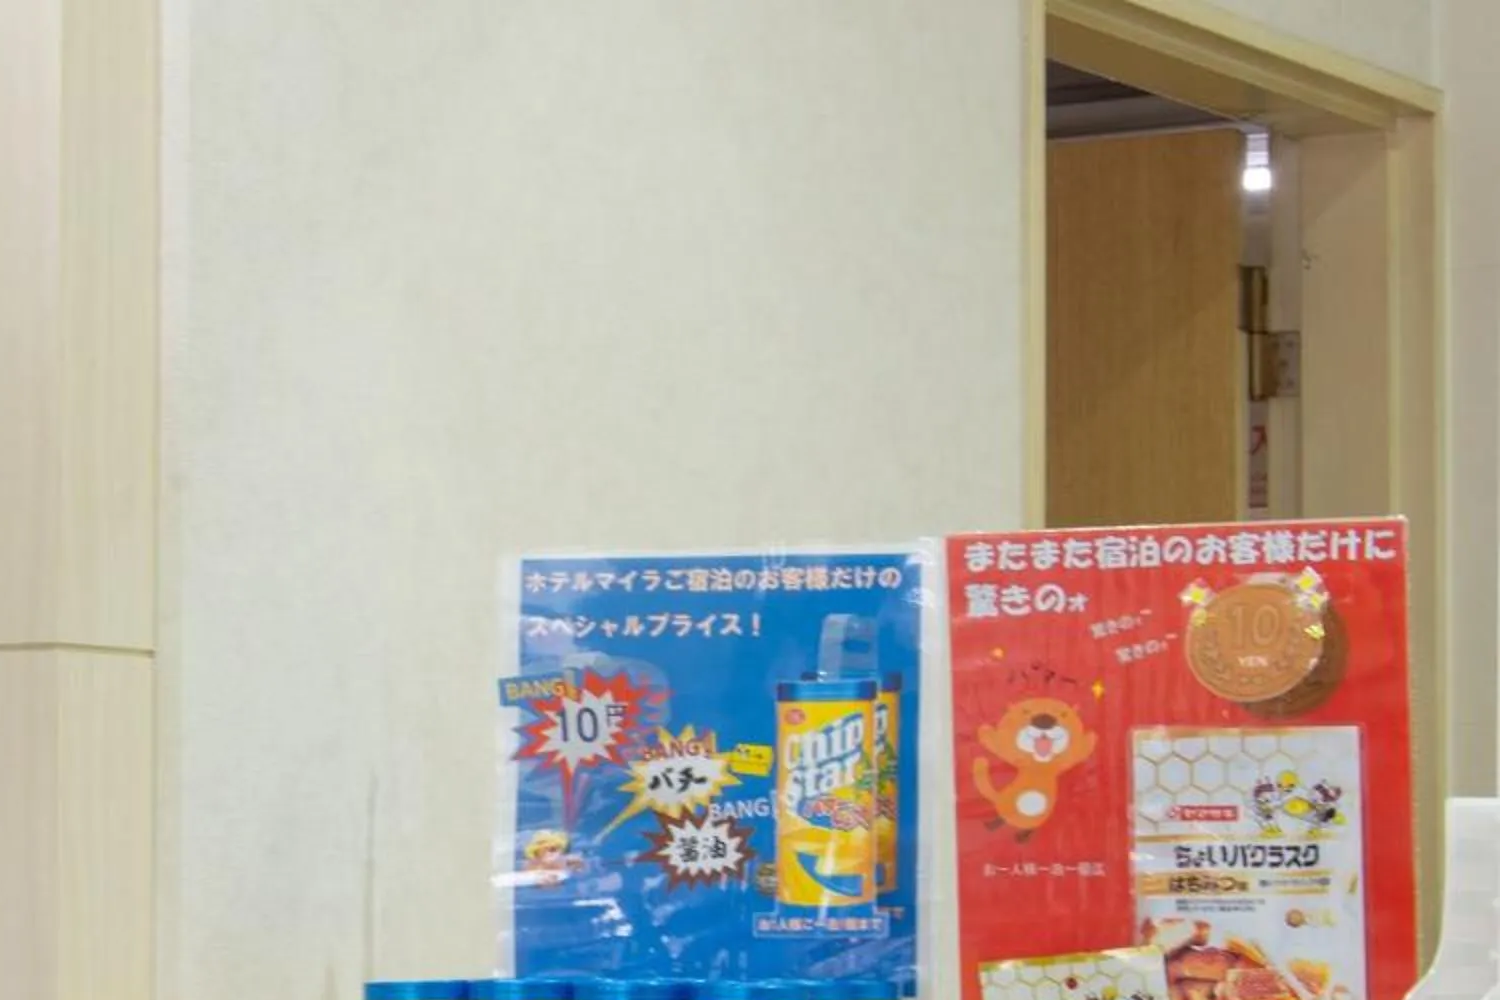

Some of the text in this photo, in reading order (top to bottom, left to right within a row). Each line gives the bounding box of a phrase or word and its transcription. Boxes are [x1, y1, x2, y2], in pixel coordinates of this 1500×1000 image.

[964, 529, 1397, 573] またまた宿泊のお客様だけに
[524, 566, 901, 593] ホテルマイラご宿泊のお客様だけの
[526, 613, 762, 638] スペシャルプライス！
[557, 705, 627, 743] 10円
